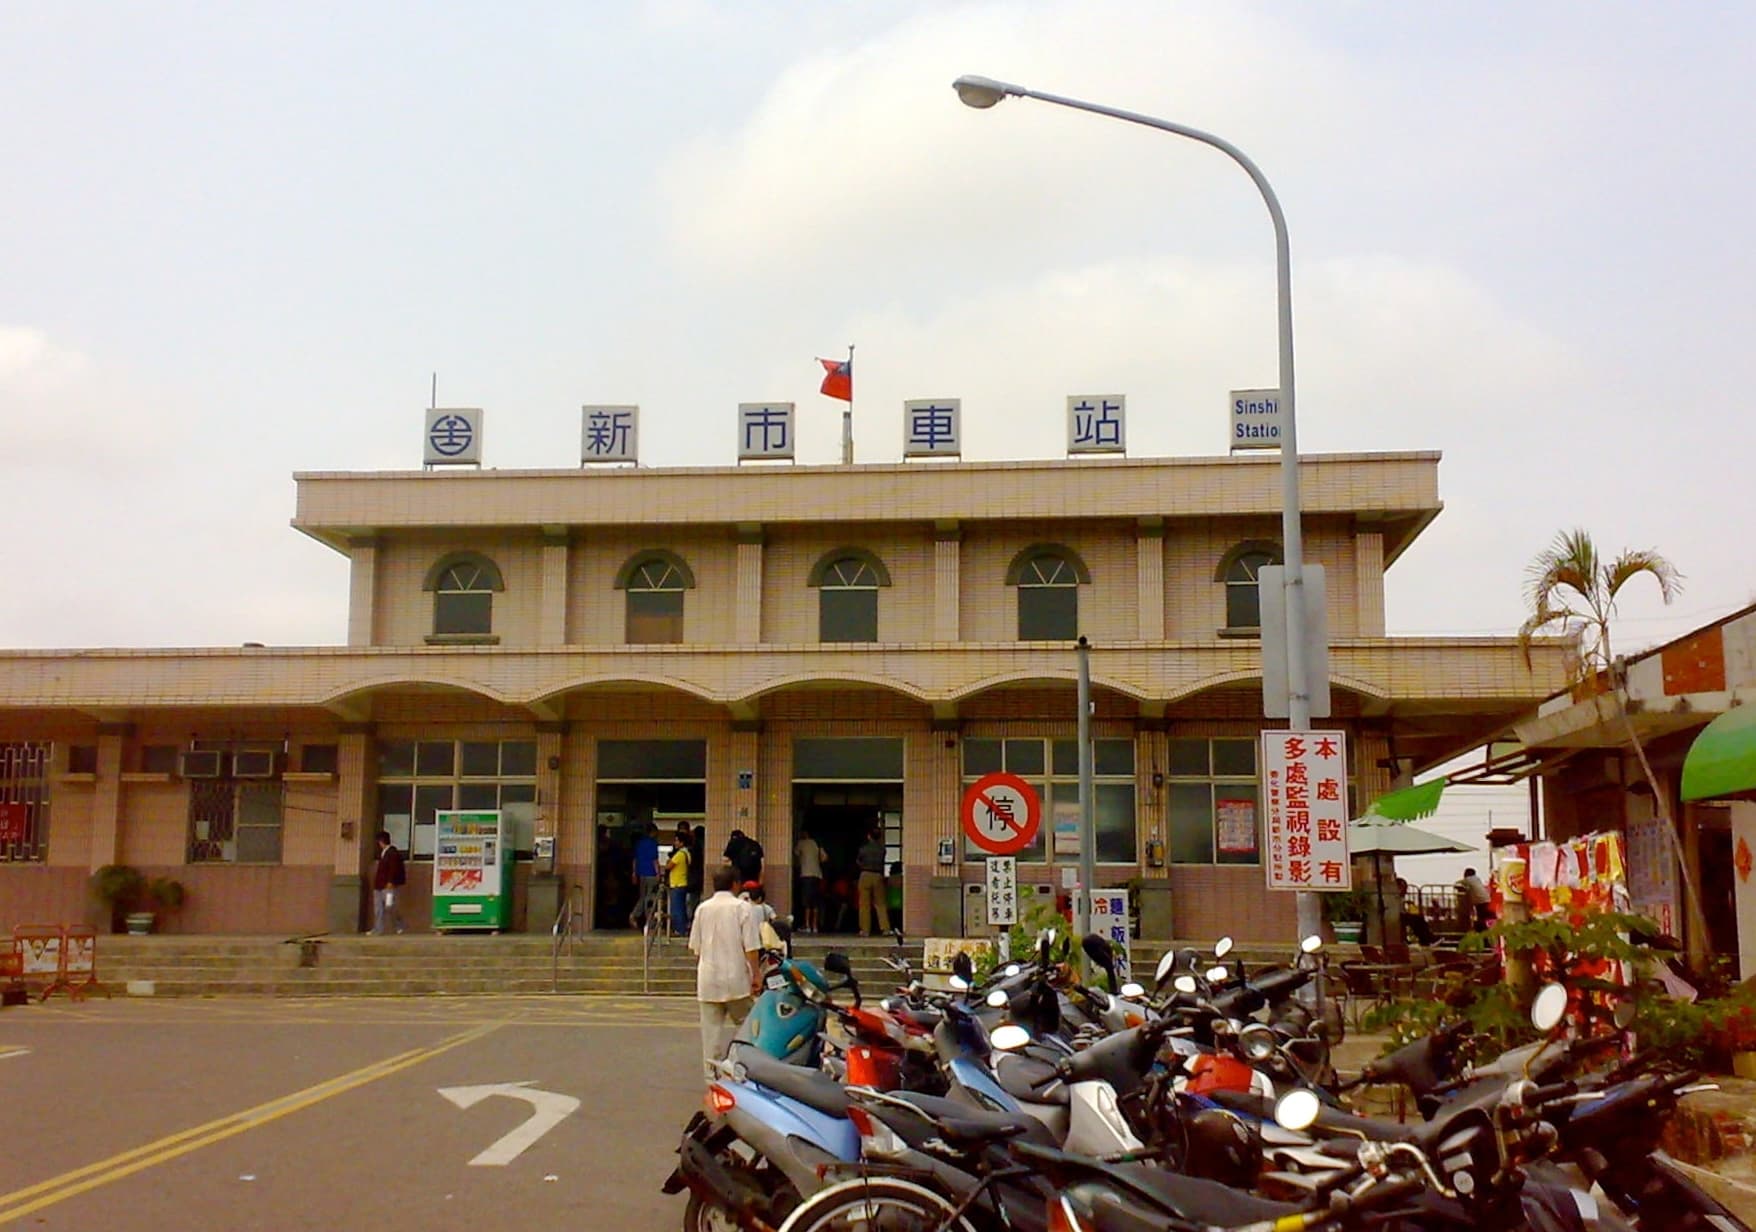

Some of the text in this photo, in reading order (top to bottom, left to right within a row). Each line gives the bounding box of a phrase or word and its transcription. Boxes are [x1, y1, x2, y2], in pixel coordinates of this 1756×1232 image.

[587, 400, 1120, 455] 新市車站
[1235, 423, 1281, 438] Statio
[986, 796, 1014, 831] 停
[1284, 737, 1312, 883] 多處監視錄影
[1314, 737, 1343, 883] 本處設有
